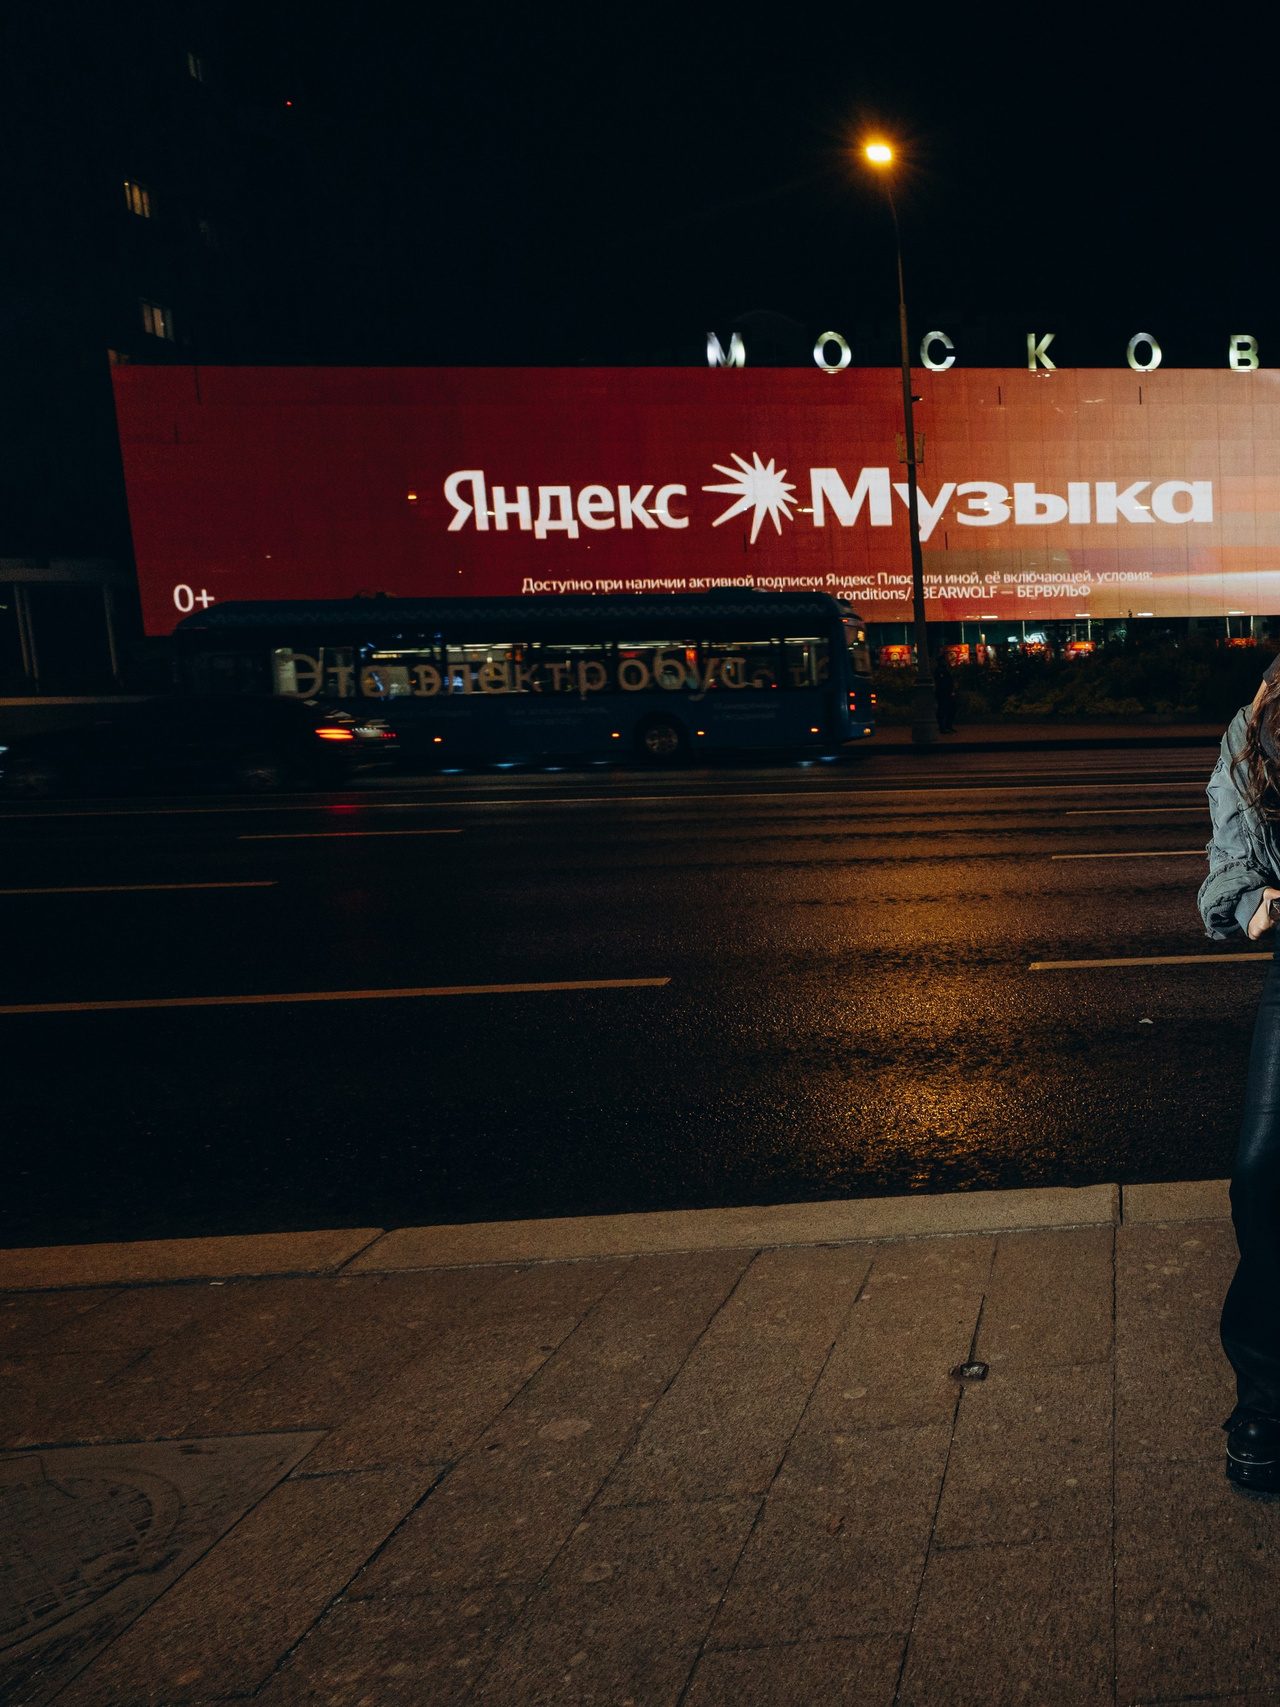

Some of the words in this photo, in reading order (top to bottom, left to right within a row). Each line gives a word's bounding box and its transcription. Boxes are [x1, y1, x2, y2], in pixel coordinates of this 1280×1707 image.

[443, 470, 689, 540] Яндекс
[809, 467, 1214, 541] Музыка
[522, 578, 593, 594] Доступно
[595, 579, 622, 593] при
[625, 578, 686, 591] наличии
[689, 575, 754, 588] активной
[757, 574, 823, 589] подписки
[826, 573, 875, 587] Яндекс
[877, 572, 914, 585] Плюс
[944, 571, 982, 586] иной,
[985, 571, 1000, 583] её
[1097, 571, 1153, 586] условия:
[1017, 585, 1091, 599] БЕРВУЛЬФ
[173, 584, 215, 613] 0+
[282, 652, 390, 699] Это
